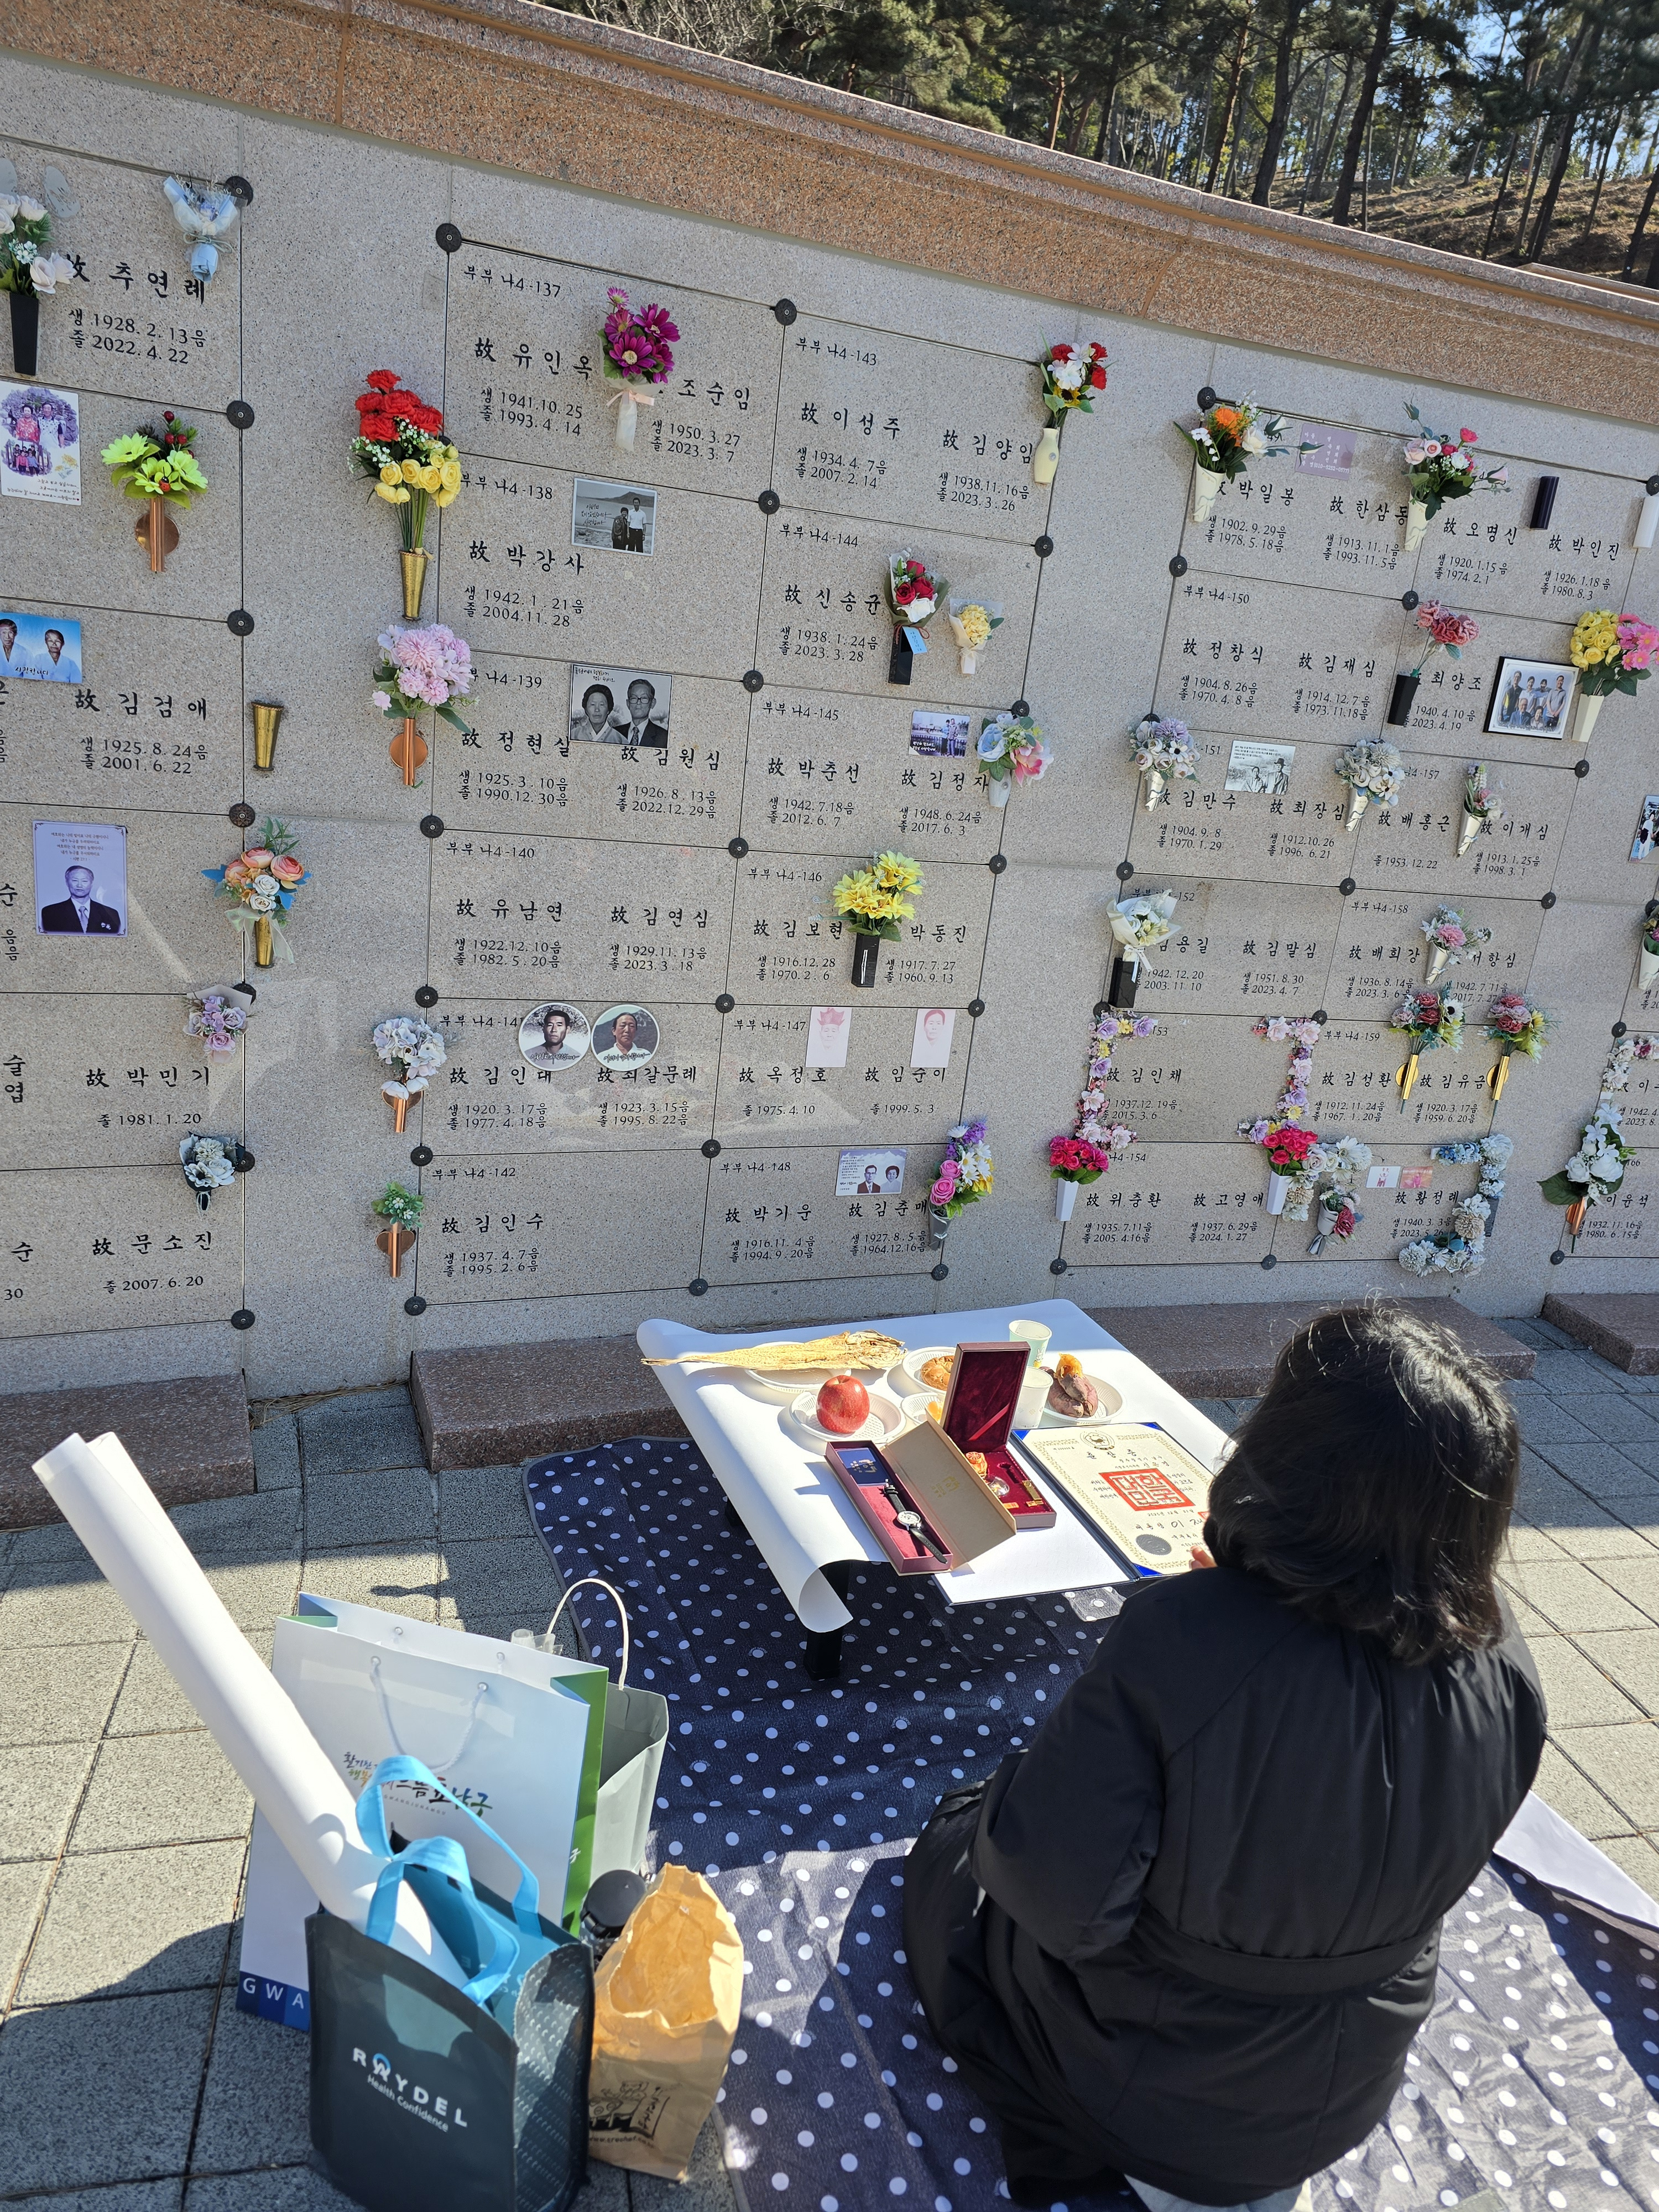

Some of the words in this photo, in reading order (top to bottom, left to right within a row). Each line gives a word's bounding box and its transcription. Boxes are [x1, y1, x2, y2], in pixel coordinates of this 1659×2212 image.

[677, 379, 750, 410] 조순임
[367, 2074, 395, 2101] Health
[397, 2095, 448, 2132] Confidence
